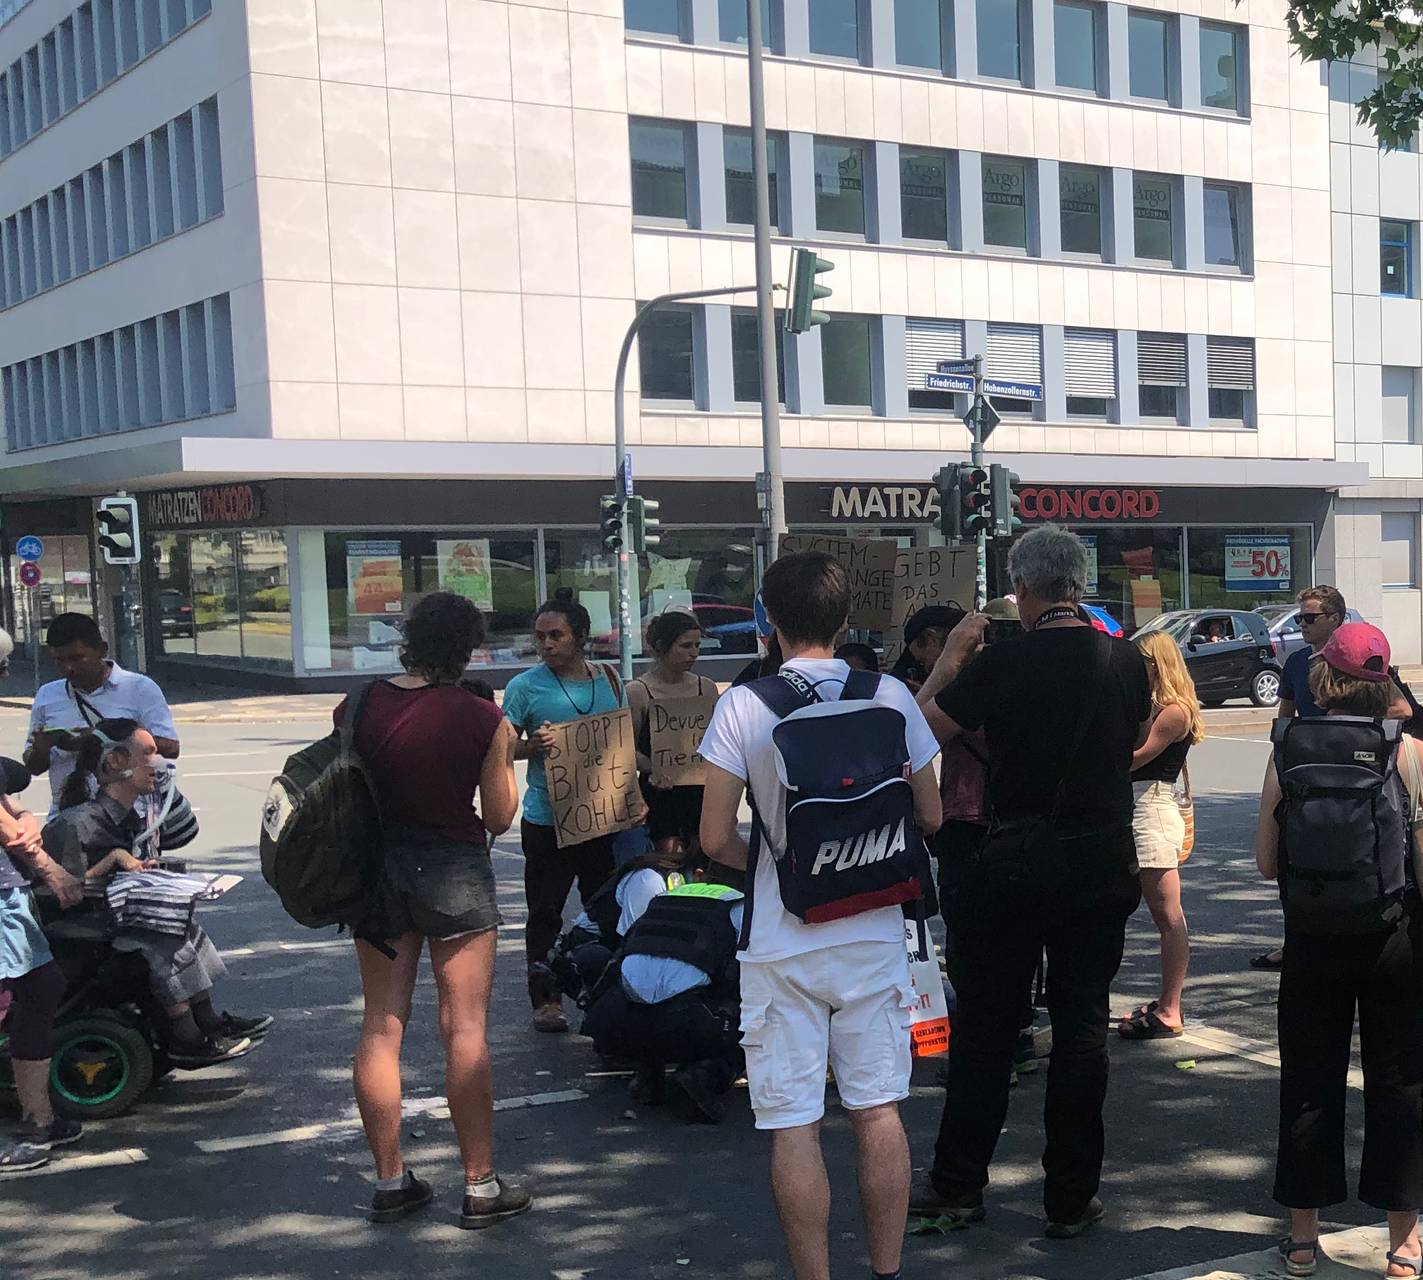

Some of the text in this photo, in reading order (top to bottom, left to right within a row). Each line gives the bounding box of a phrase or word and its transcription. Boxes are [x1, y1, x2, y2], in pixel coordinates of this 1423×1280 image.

[901, 159, 942, 182] Argo
[984, 168, 1020, 191] Argo
[1062, 175, 1096, 201] Argo
[1135, 184, 1167, 207] Argo
[930, 377, 972, 390] Friedrichstr.
[984, 382, 1039, 398] Hohenzollernstr.
[148, 485, 255, 525] MATRATZEN CONCORD
[1018, 487, 1160, 519] CONCORD
[893, 550, 967, 578] GEBT
[901, 583, 939, 600] DAS
[654, 704, 708, 733] Devue
[549, 713, 628, 760] STOPPT
[583, 754, 604, 769] die
[550, 754, 629, 801] Blut-
[555, 790, 639, 843] KOHLE
[811, 816, 906, 875] PUMA
